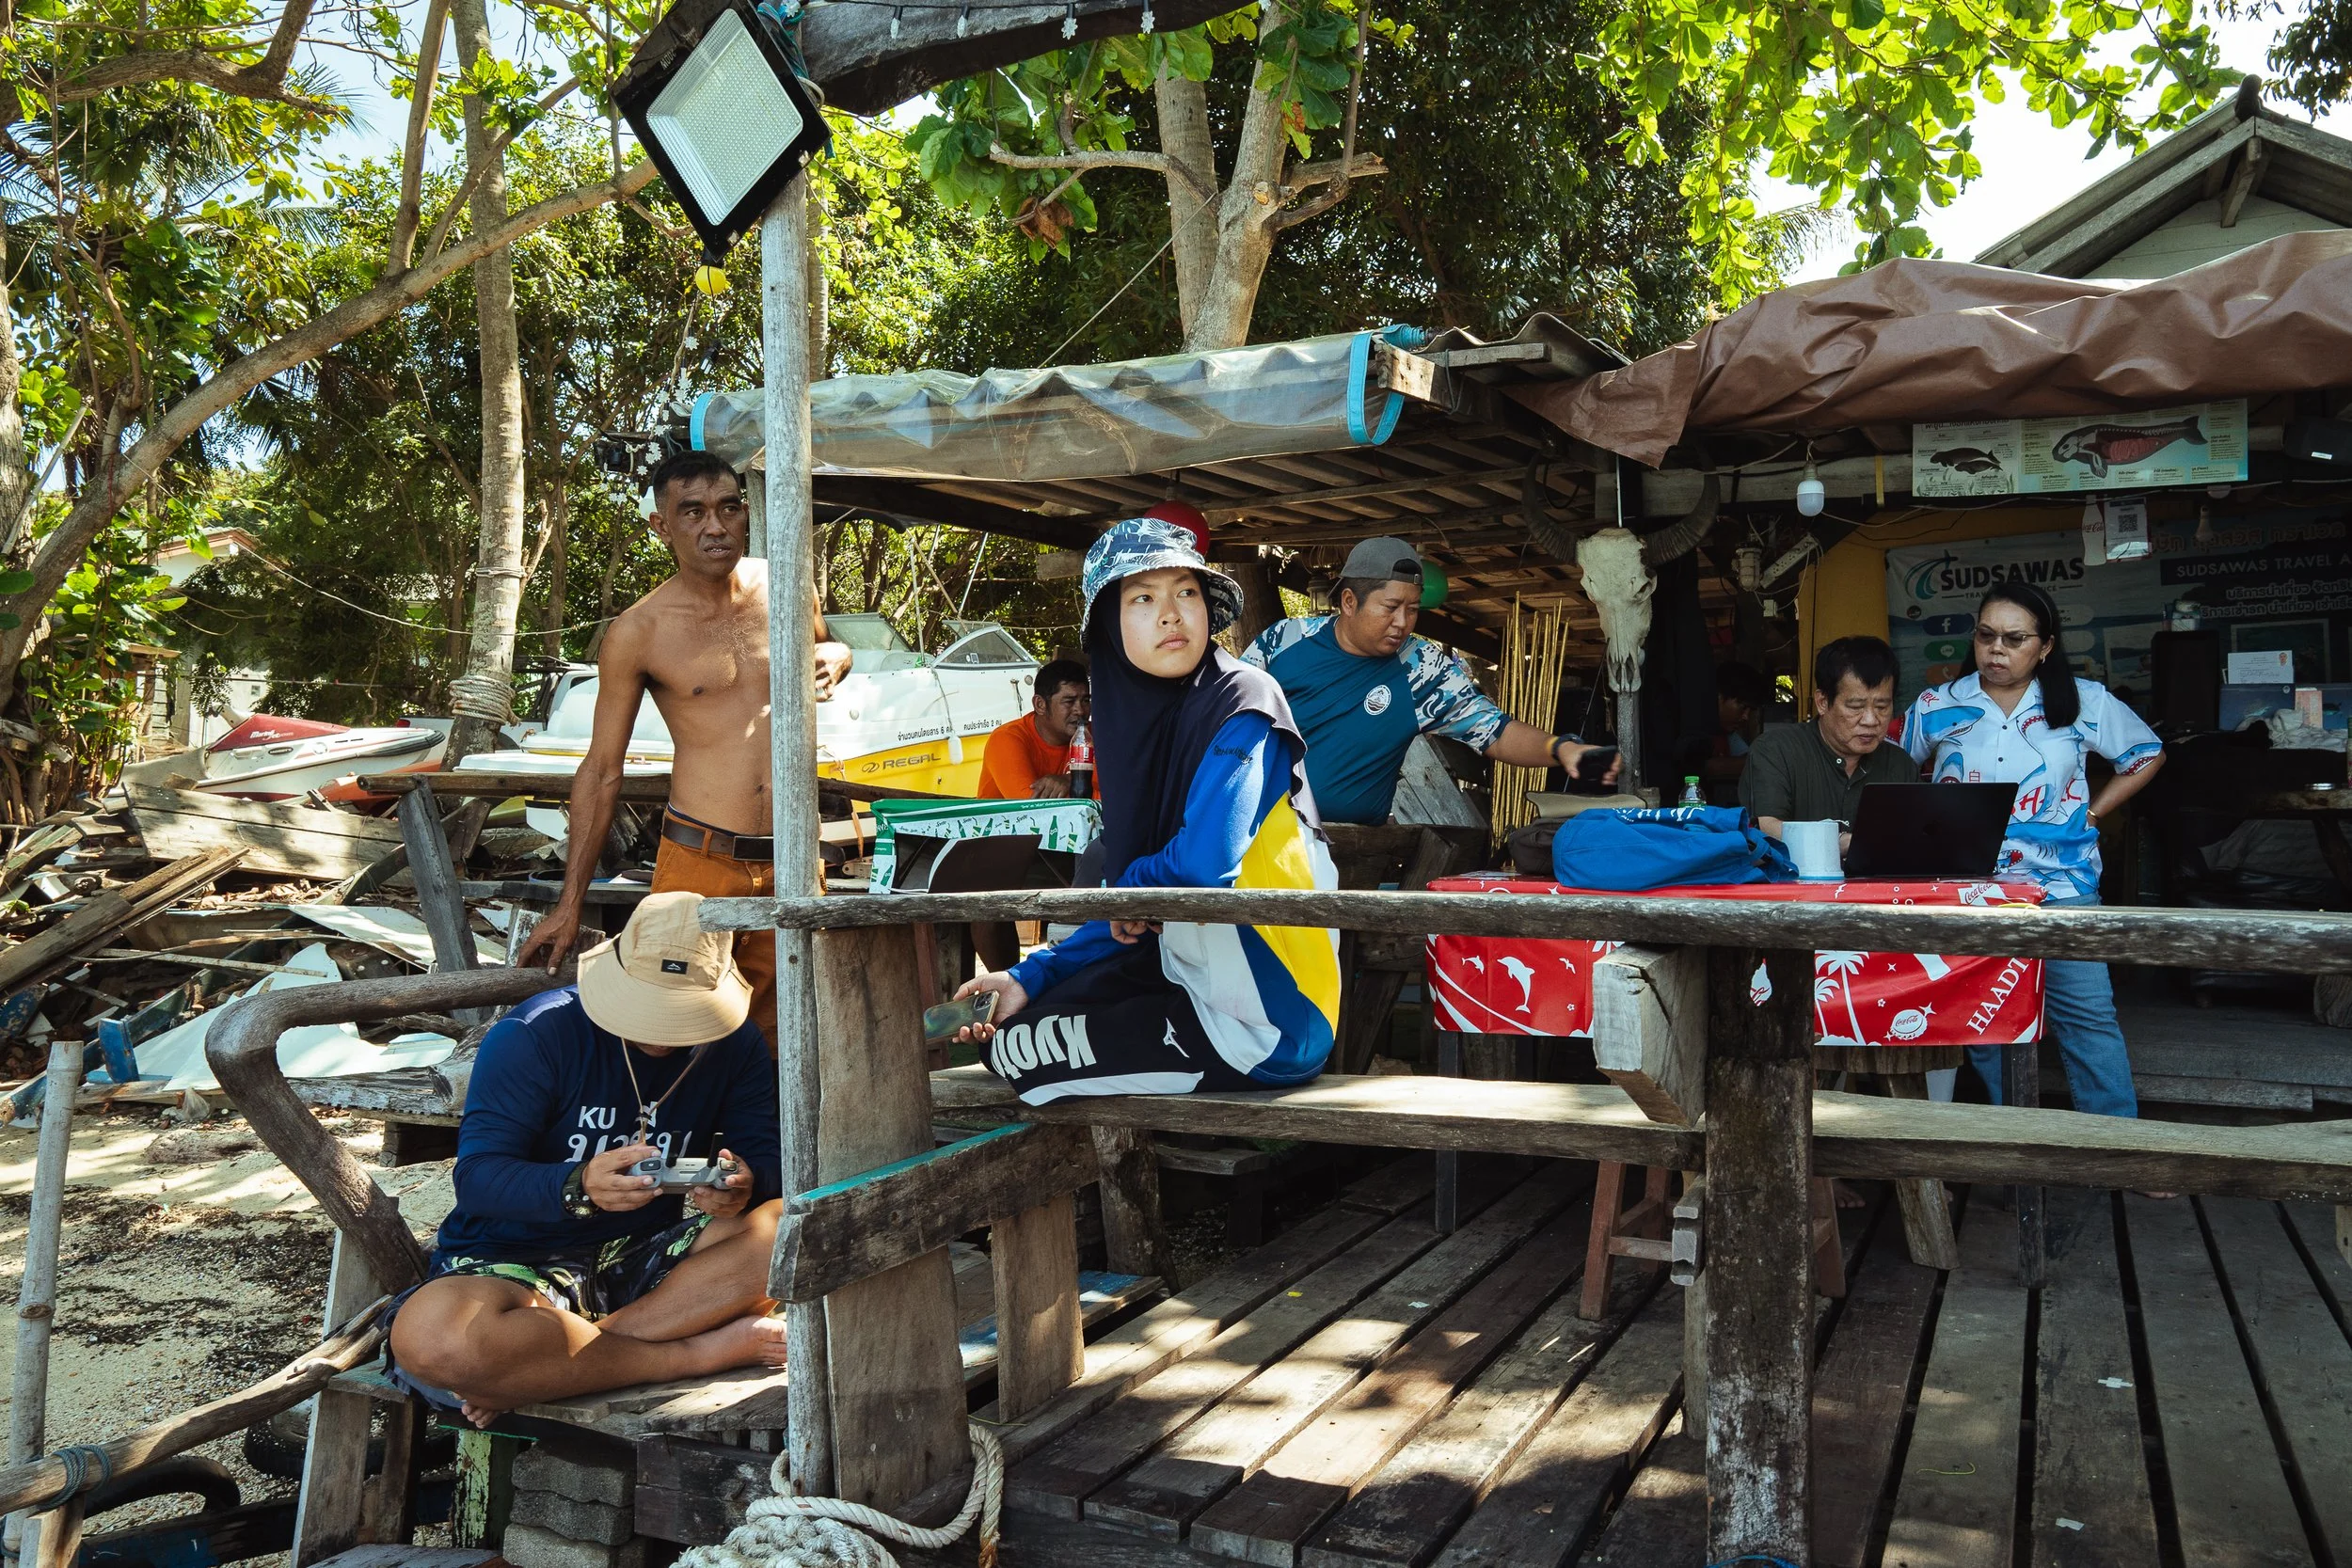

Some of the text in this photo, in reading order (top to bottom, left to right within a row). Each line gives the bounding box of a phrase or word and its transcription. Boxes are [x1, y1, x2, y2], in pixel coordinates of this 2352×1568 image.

[1940, 557, 2085, 592] SUDSAWAS
[2177, 558, 2268, 578] SUDSAWAS
[2274, 552, 2333, 570] TRAVEL
[882, 752, 941, 769] REGAL
[578, 1106, 616, 1129] KU
